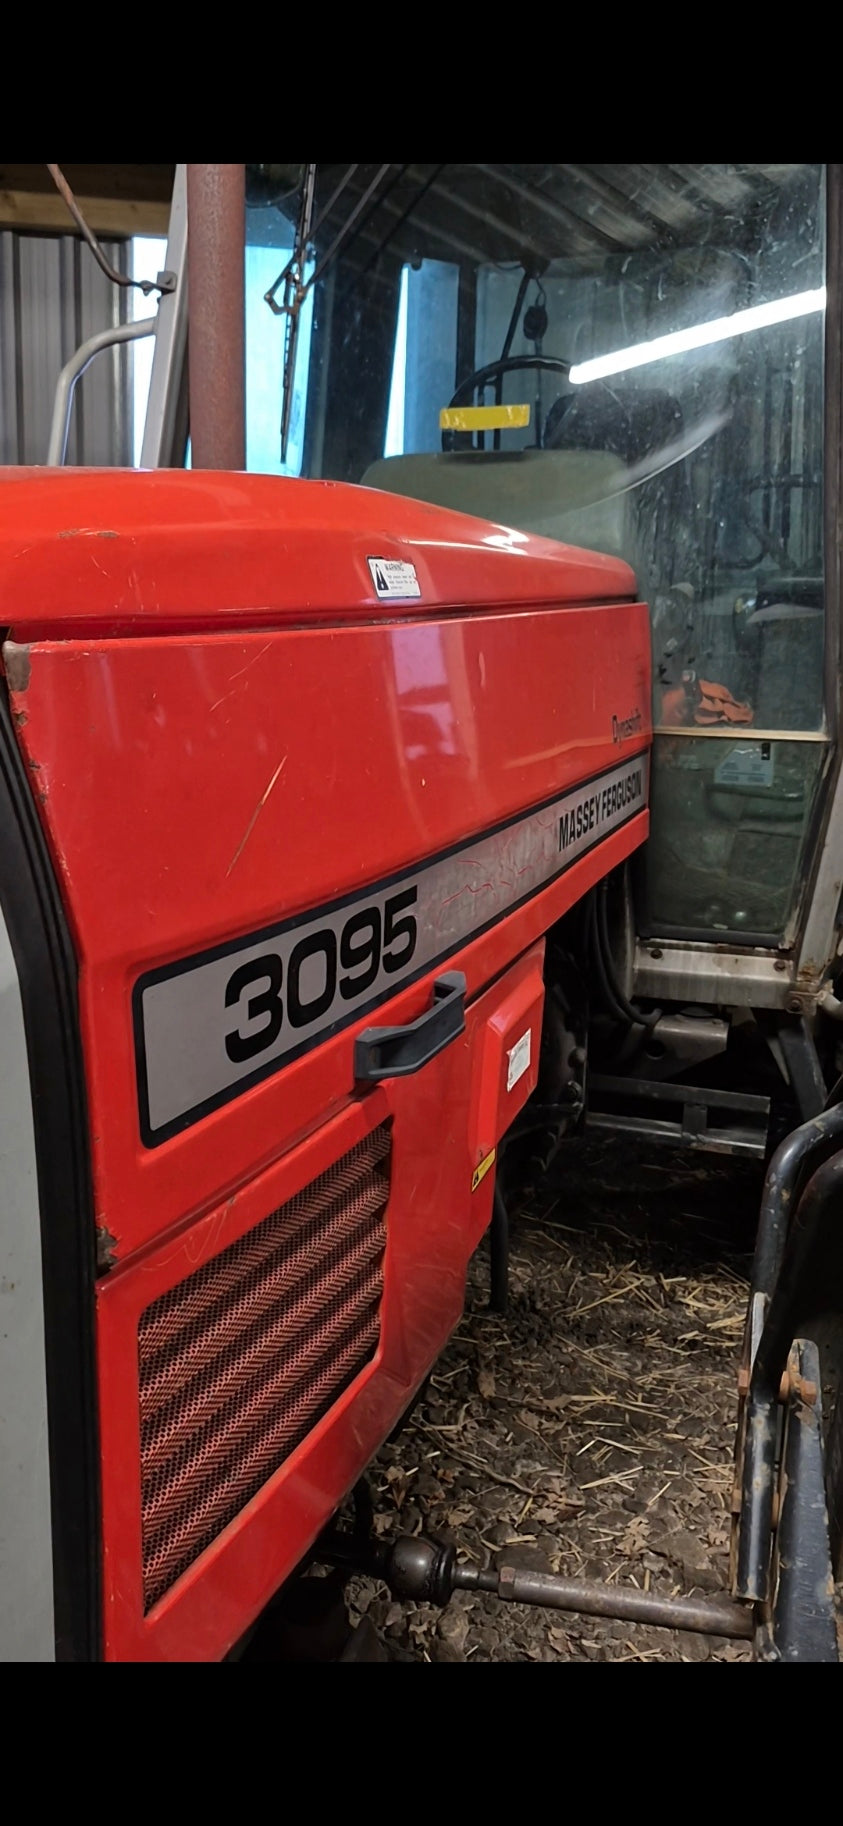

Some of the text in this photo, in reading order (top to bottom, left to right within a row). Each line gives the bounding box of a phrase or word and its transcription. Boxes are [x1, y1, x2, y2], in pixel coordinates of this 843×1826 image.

[559, 769, 642, 852] MASSEY FERGUSON
[225, 885, 418, 1063] 3095
